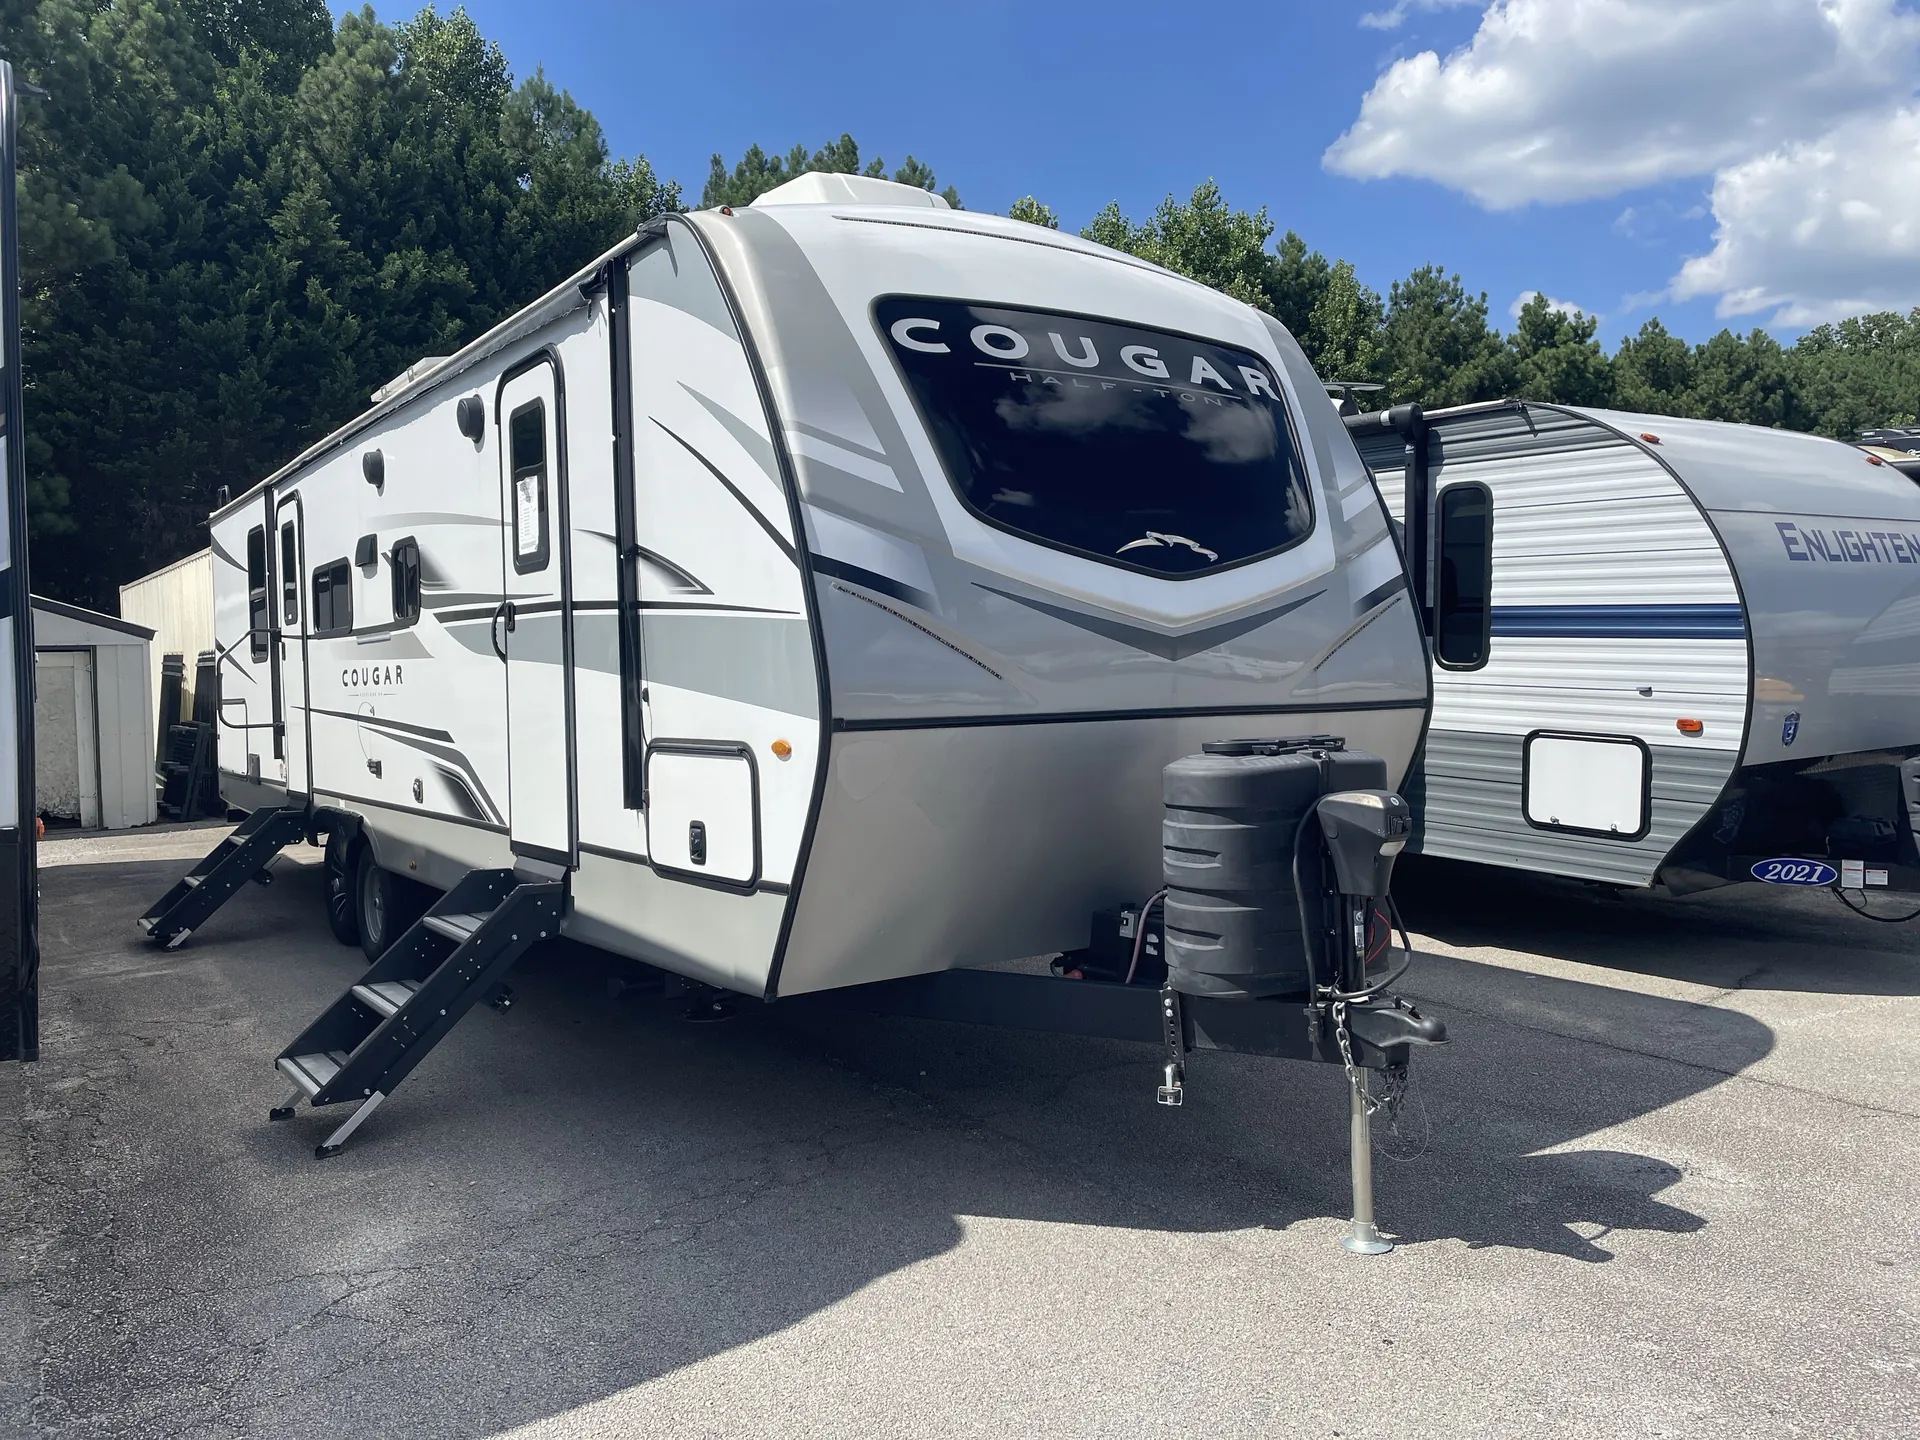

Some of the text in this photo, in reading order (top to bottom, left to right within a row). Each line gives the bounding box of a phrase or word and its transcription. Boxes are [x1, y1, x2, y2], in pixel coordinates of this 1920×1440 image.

[890, 317, 1281, 401] COUGAR
[1009, 371, 1222, 407] HALF-TON
[1774, 521, 1920, 564] ENLIGHTEN
[341, 664, 404, 687] COUGAR
[1764, 863, 1824, 882] 2021
